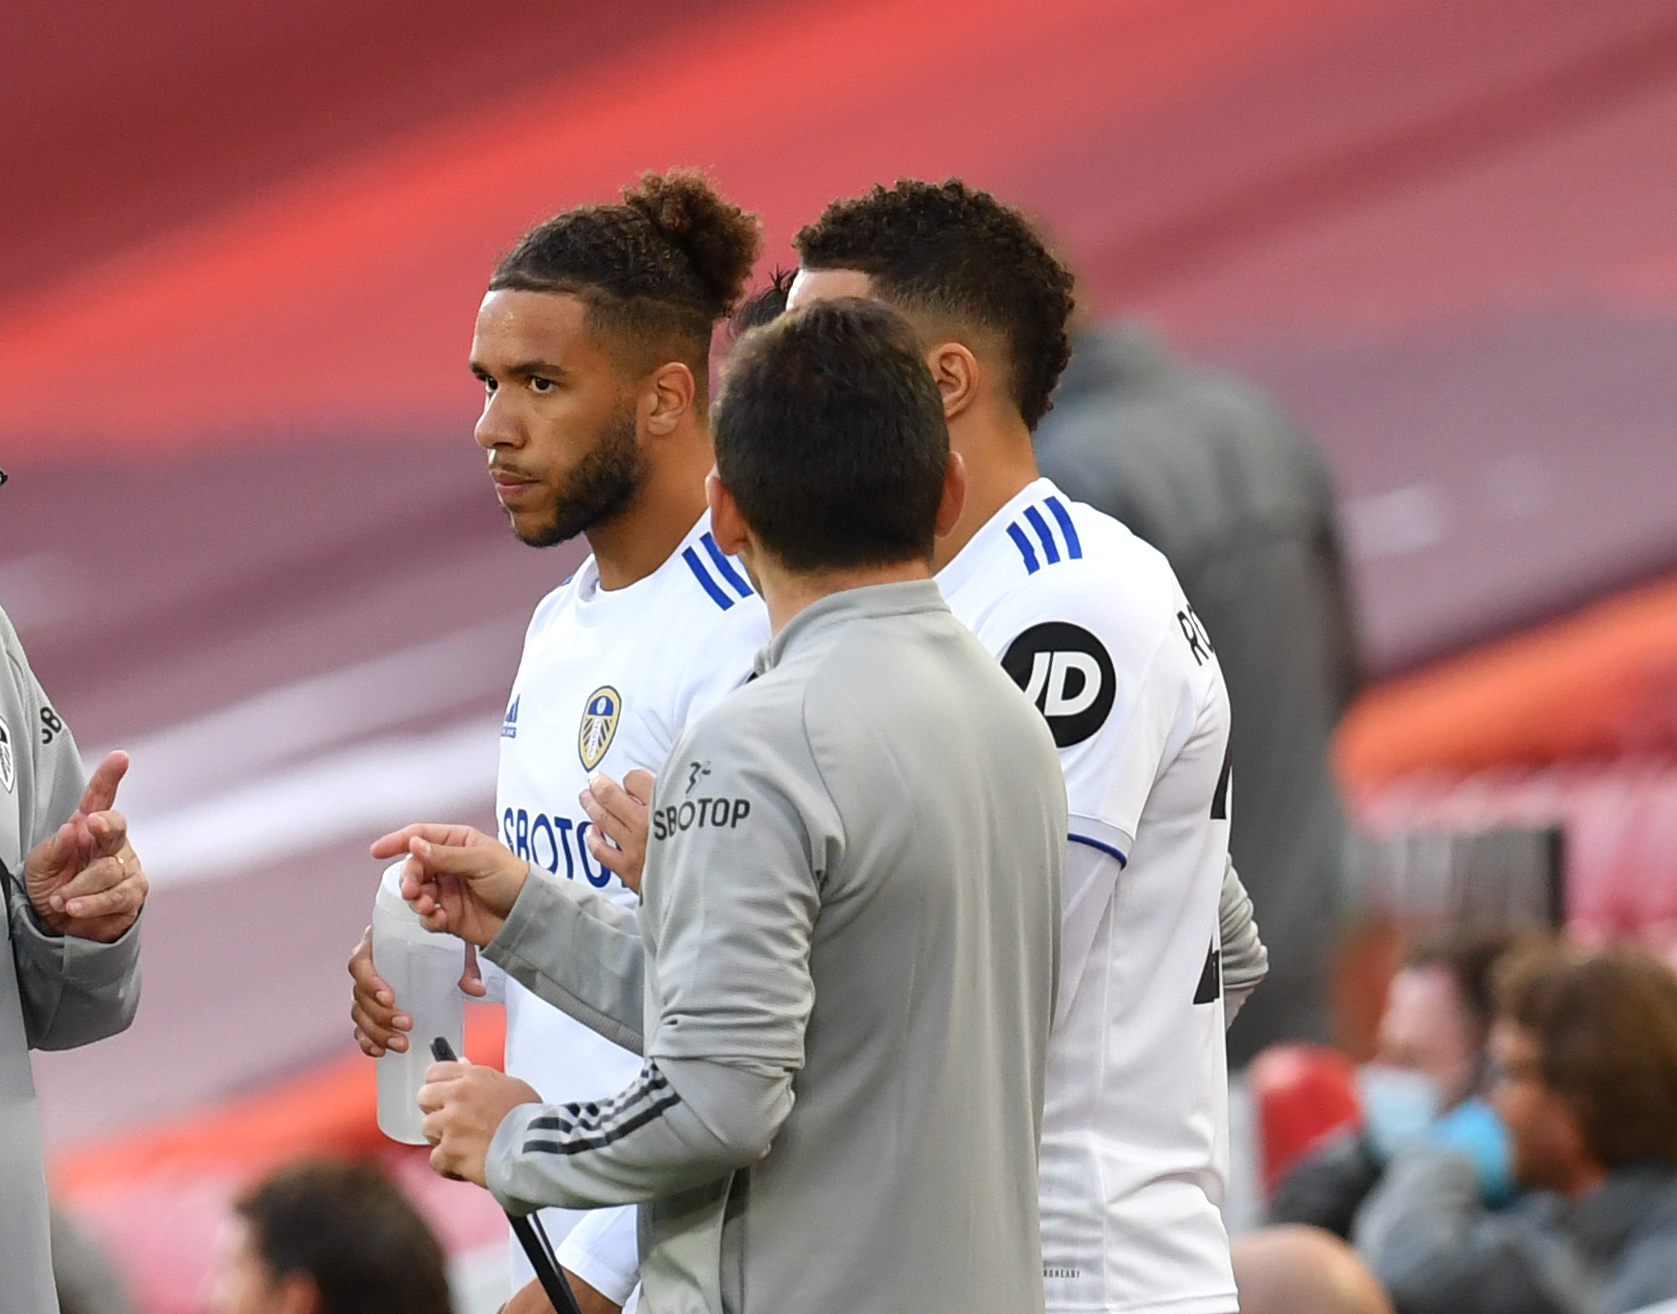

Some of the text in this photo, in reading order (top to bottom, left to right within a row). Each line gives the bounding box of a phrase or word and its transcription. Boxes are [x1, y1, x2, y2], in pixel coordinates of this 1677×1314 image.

[1024, 651, 1102, 716] JD
[503, 807, 630, 888] SBOTO
[653, 797, 751, 841] SBOTOP
